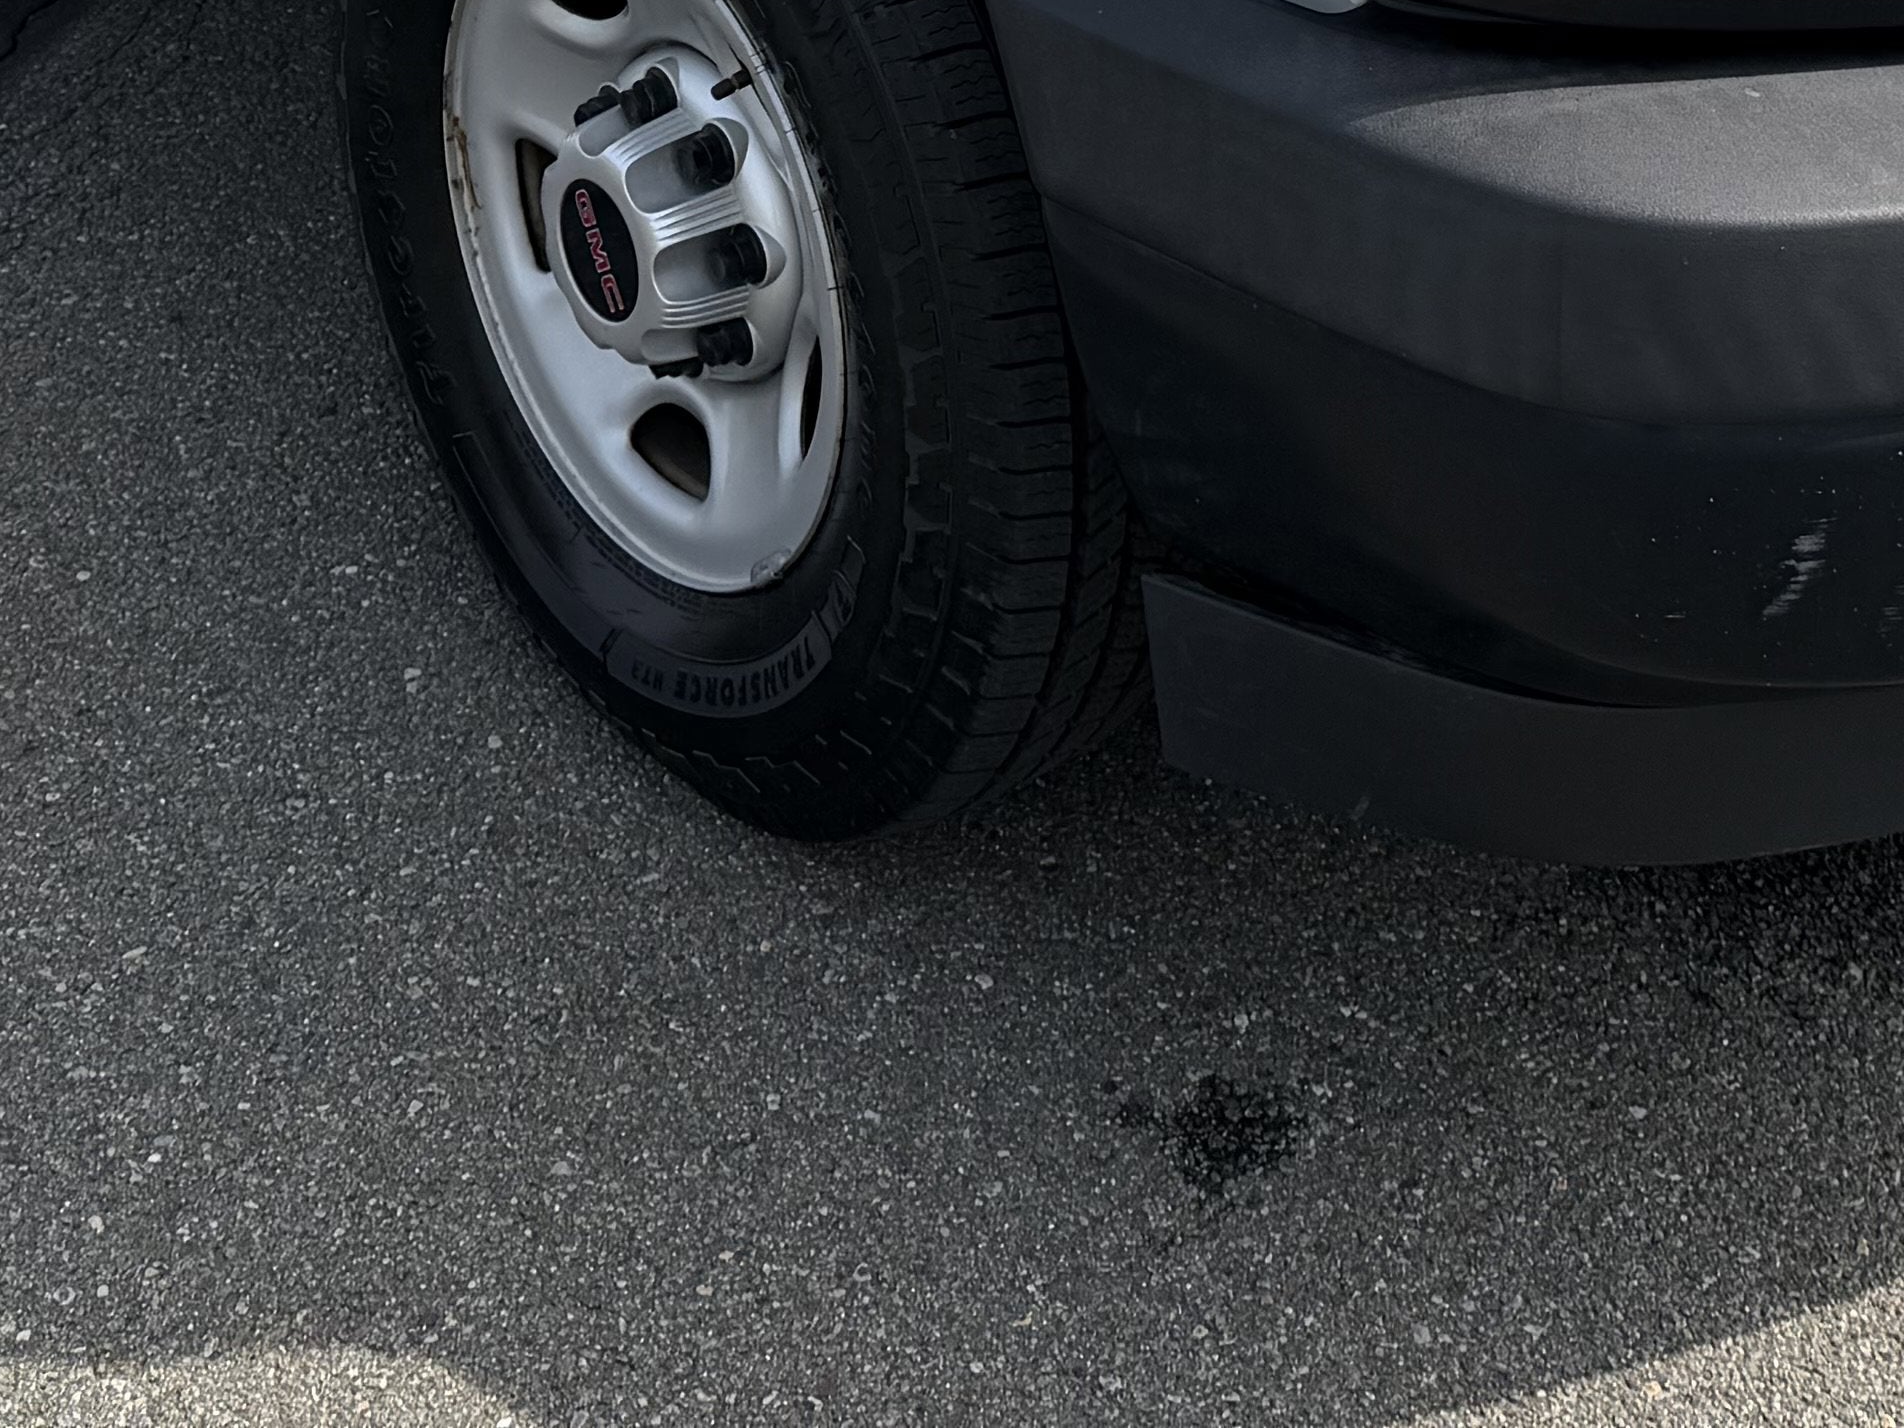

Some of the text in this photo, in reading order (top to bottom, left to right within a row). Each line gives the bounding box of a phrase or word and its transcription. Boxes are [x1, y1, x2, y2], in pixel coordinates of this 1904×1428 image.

[575, 189, 626, 316] GMC
[630, 636, 816, 706] TRANSFORCE HT3
